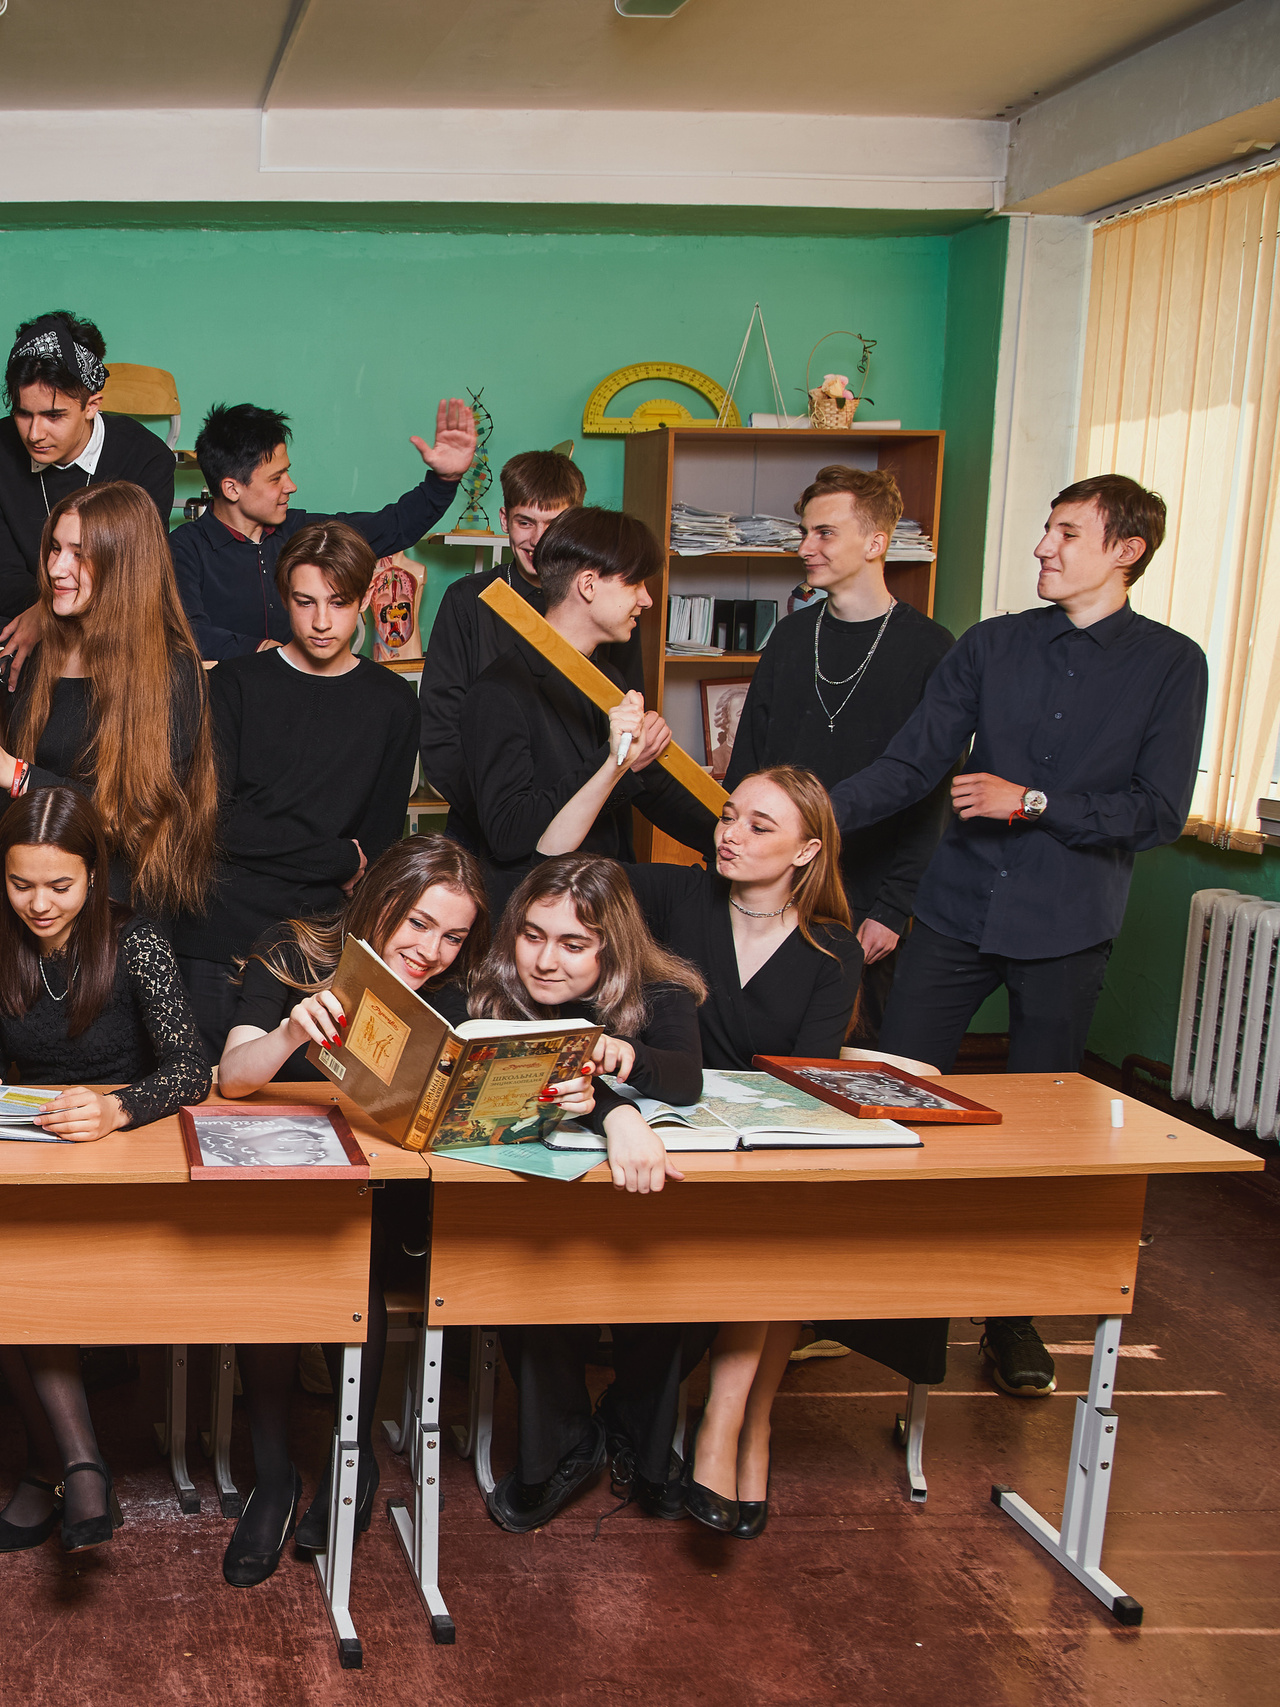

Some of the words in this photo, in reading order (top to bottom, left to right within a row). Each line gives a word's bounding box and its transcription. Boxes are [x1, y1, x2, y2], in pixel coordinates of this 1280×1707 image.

[492, 1071, 545, 1082] ШКОЛЬНАЯ
[490, 1078, 543, 1087] ЭНЦИКЛОПЕДИЯ
[421, 1073, 442, 1112] ШКОЛЬНАЯ
